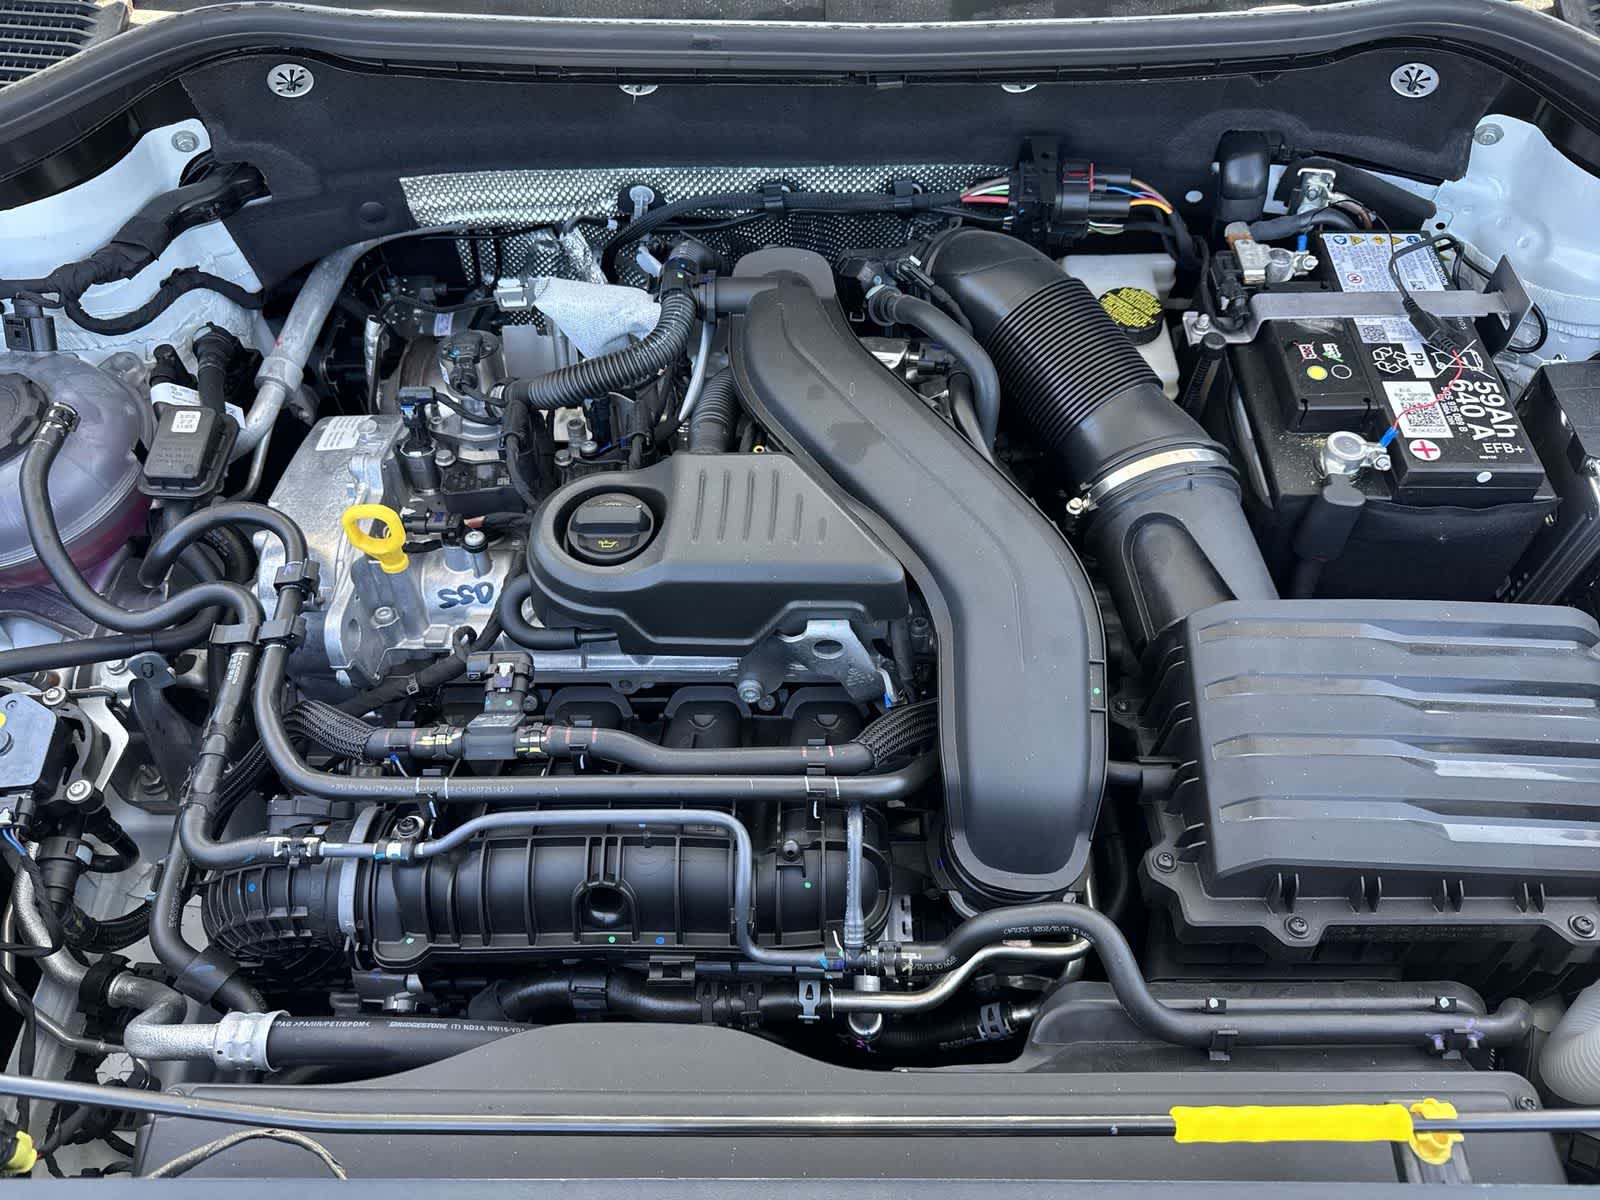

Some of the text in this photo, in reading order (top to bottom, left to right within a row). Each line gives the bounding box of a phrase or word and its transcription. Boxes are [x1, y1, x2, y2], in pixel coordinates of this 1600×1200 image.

[1410, 352, 1424, 367] Pb
[1449, 379, 1485, 418] 640
[1467, 422, 1496, 441] A
[1474, 381, 1519, 438] 59Ah
[1481, 442, 1526, 454] EFB+
